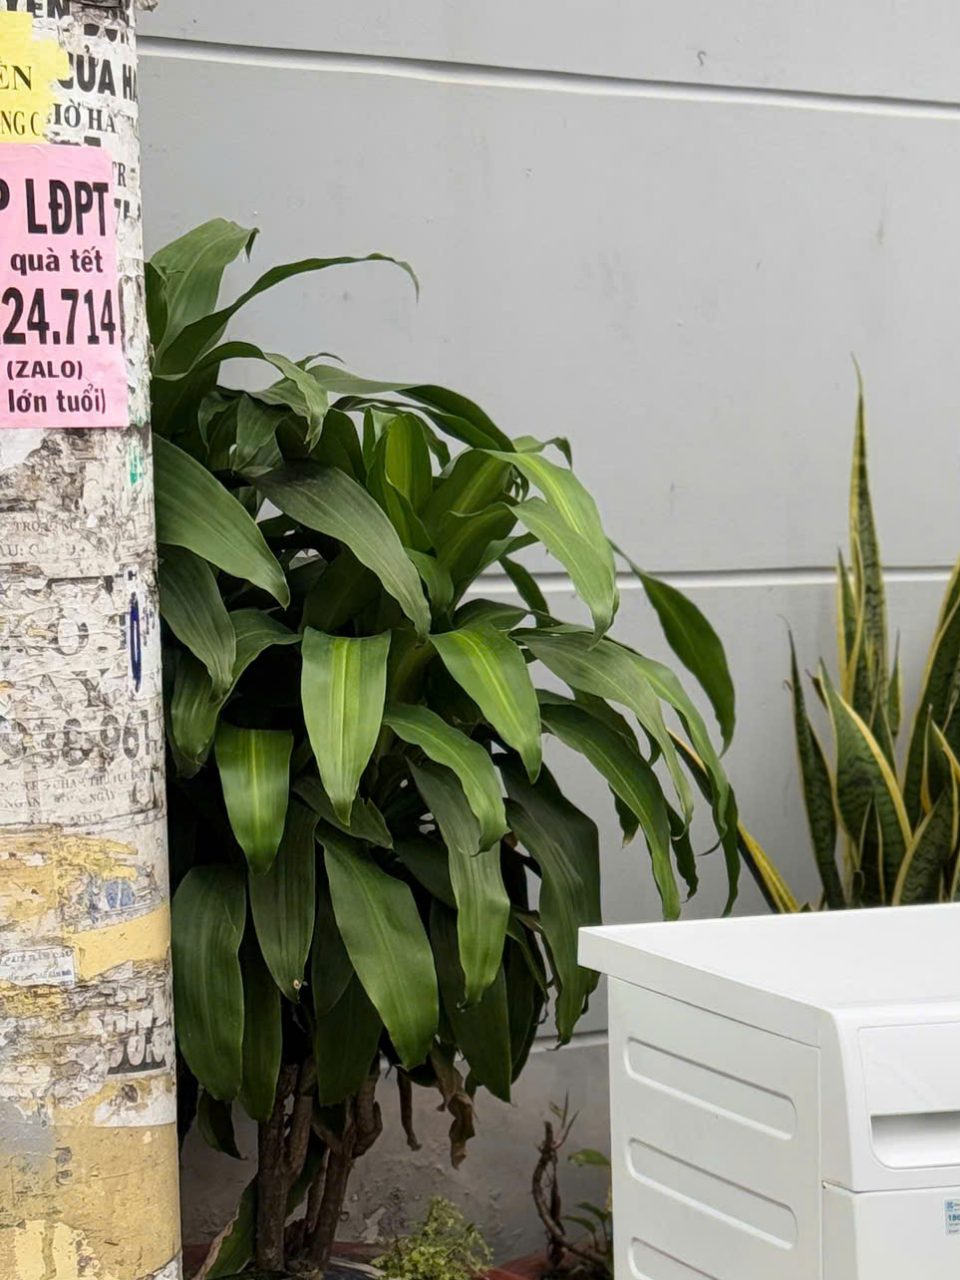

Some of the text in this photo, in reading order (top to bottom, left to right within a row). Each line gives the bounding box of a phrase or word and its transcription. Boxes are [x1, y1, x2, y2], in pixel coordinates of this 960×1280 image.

[46, 99, 82, 129] IỜ
[25, 178, 109, 236] LĐPT
[11, 246, 103, 276] quà tết
[2, 287, 116, 345] 24.714
[7, 360, 83, 379] (ZALO)
[8, 383, 106, 414] lớn tuổi)
